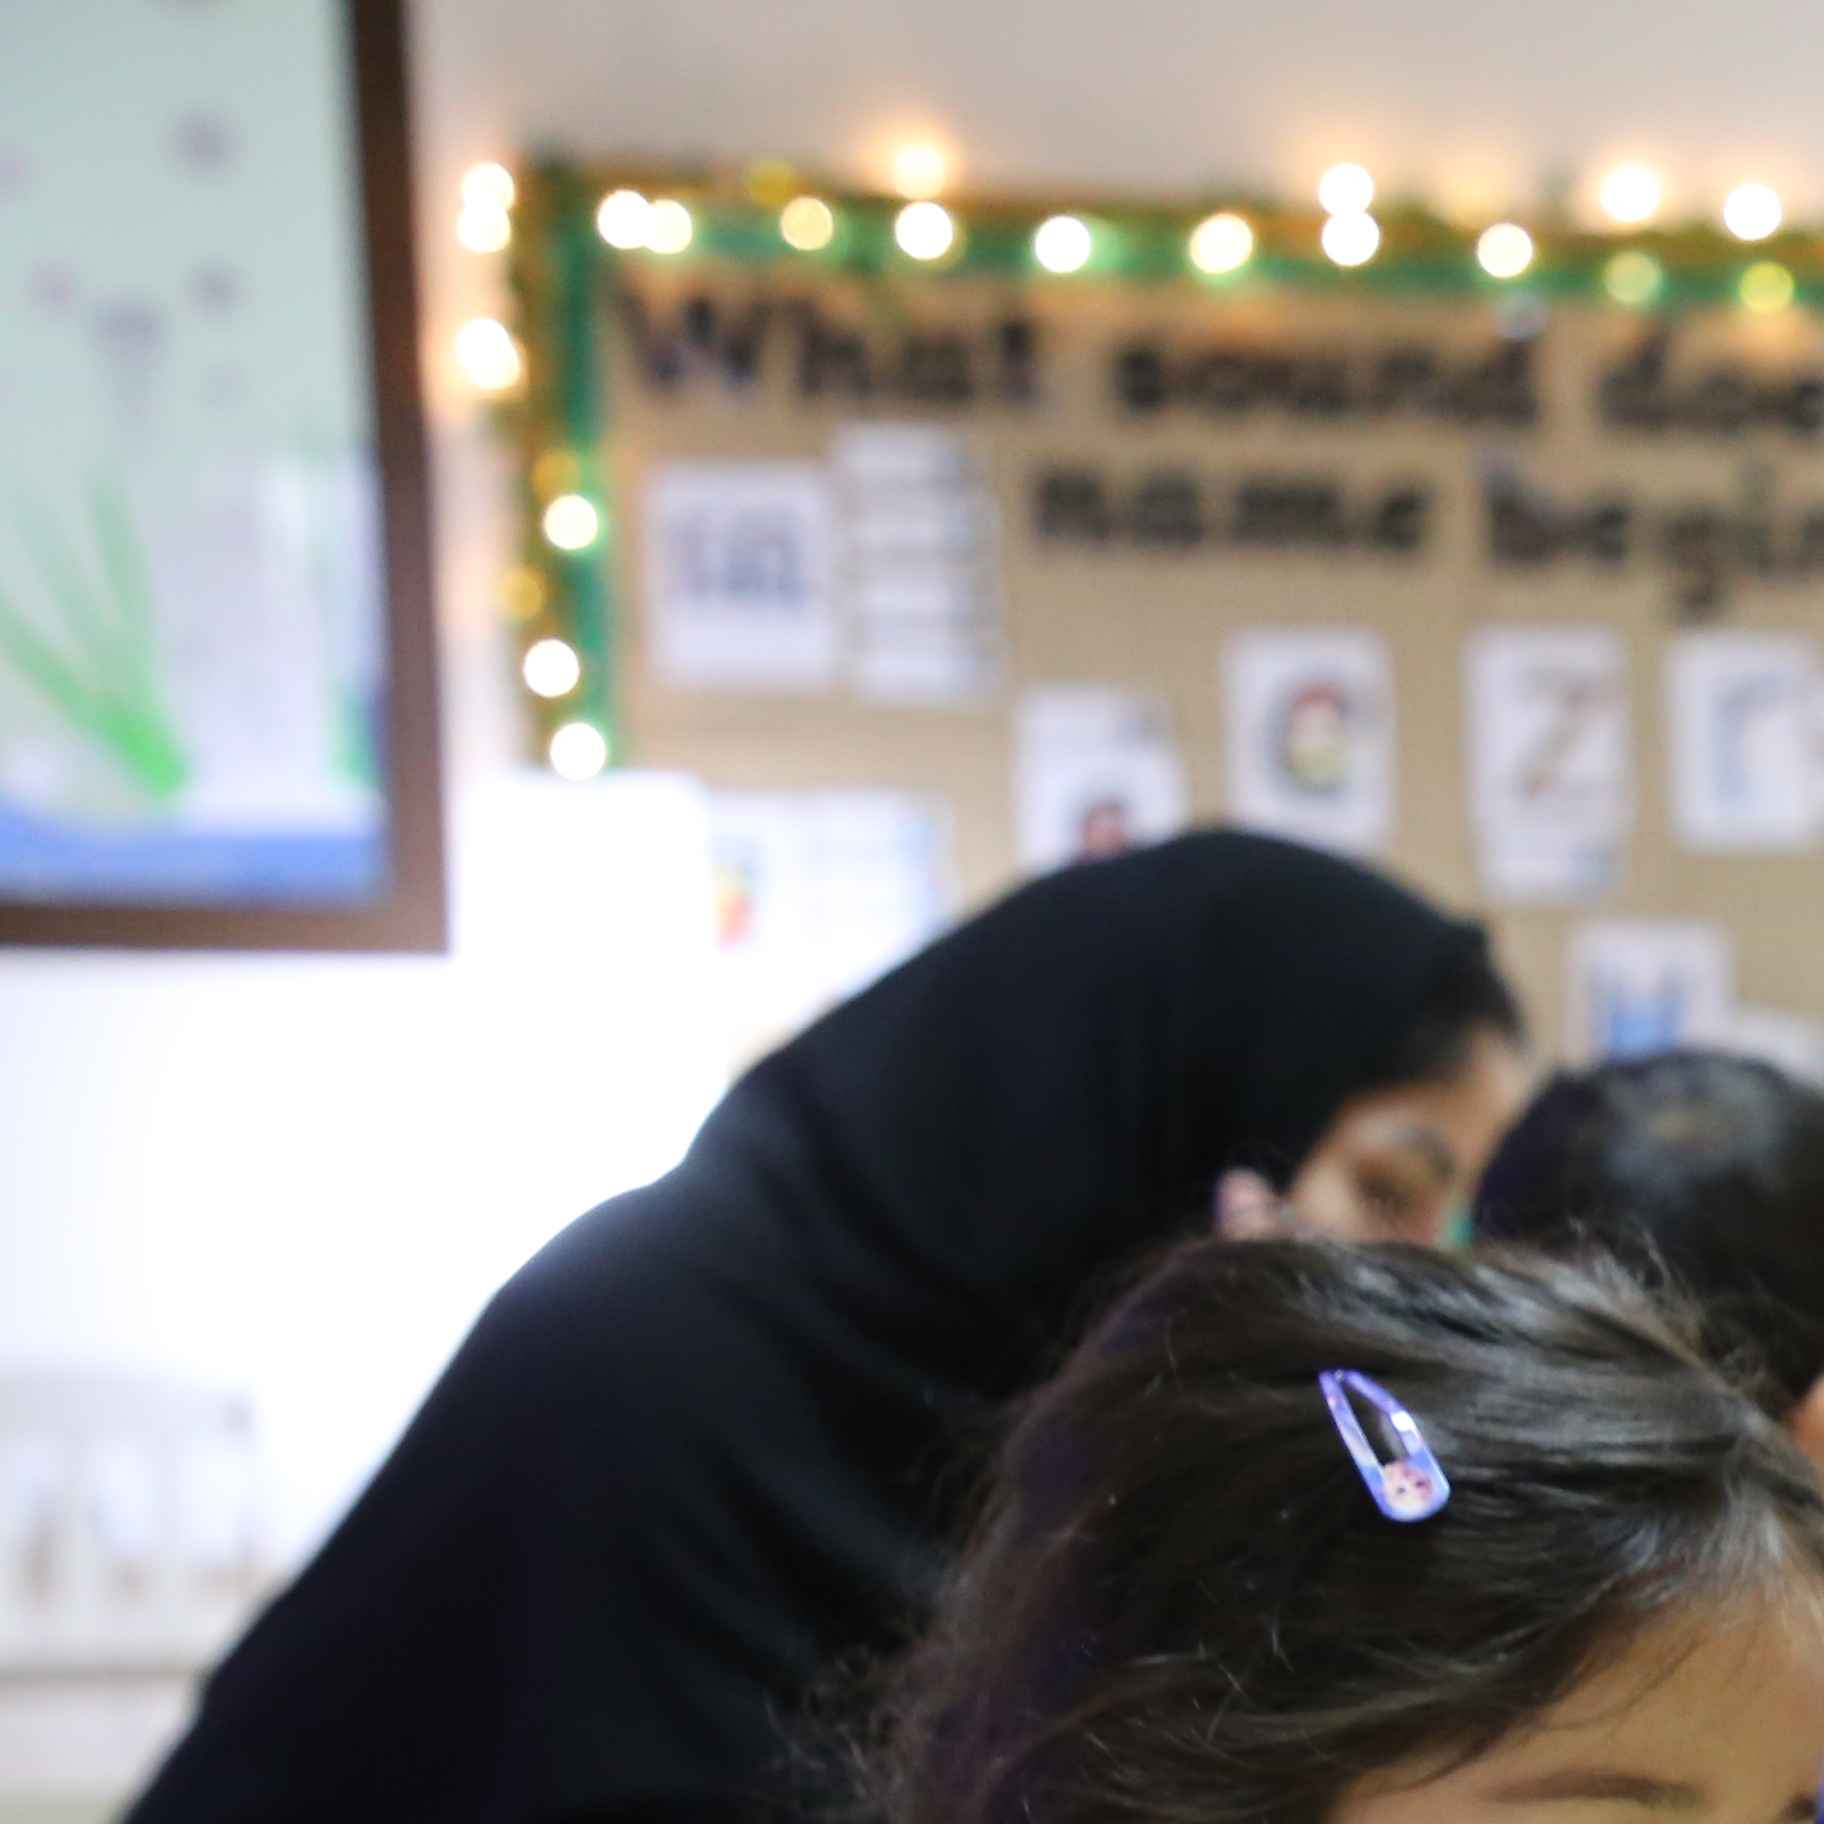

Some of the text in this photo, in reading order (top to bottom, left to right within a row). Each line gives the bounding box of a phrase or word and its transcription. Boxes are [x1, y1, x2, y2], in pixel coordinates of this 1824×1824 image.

[616, 288, 1042, 406] What
[1110, 332, 1540, 422] sound
[1033, 465, 1436, 556] name
